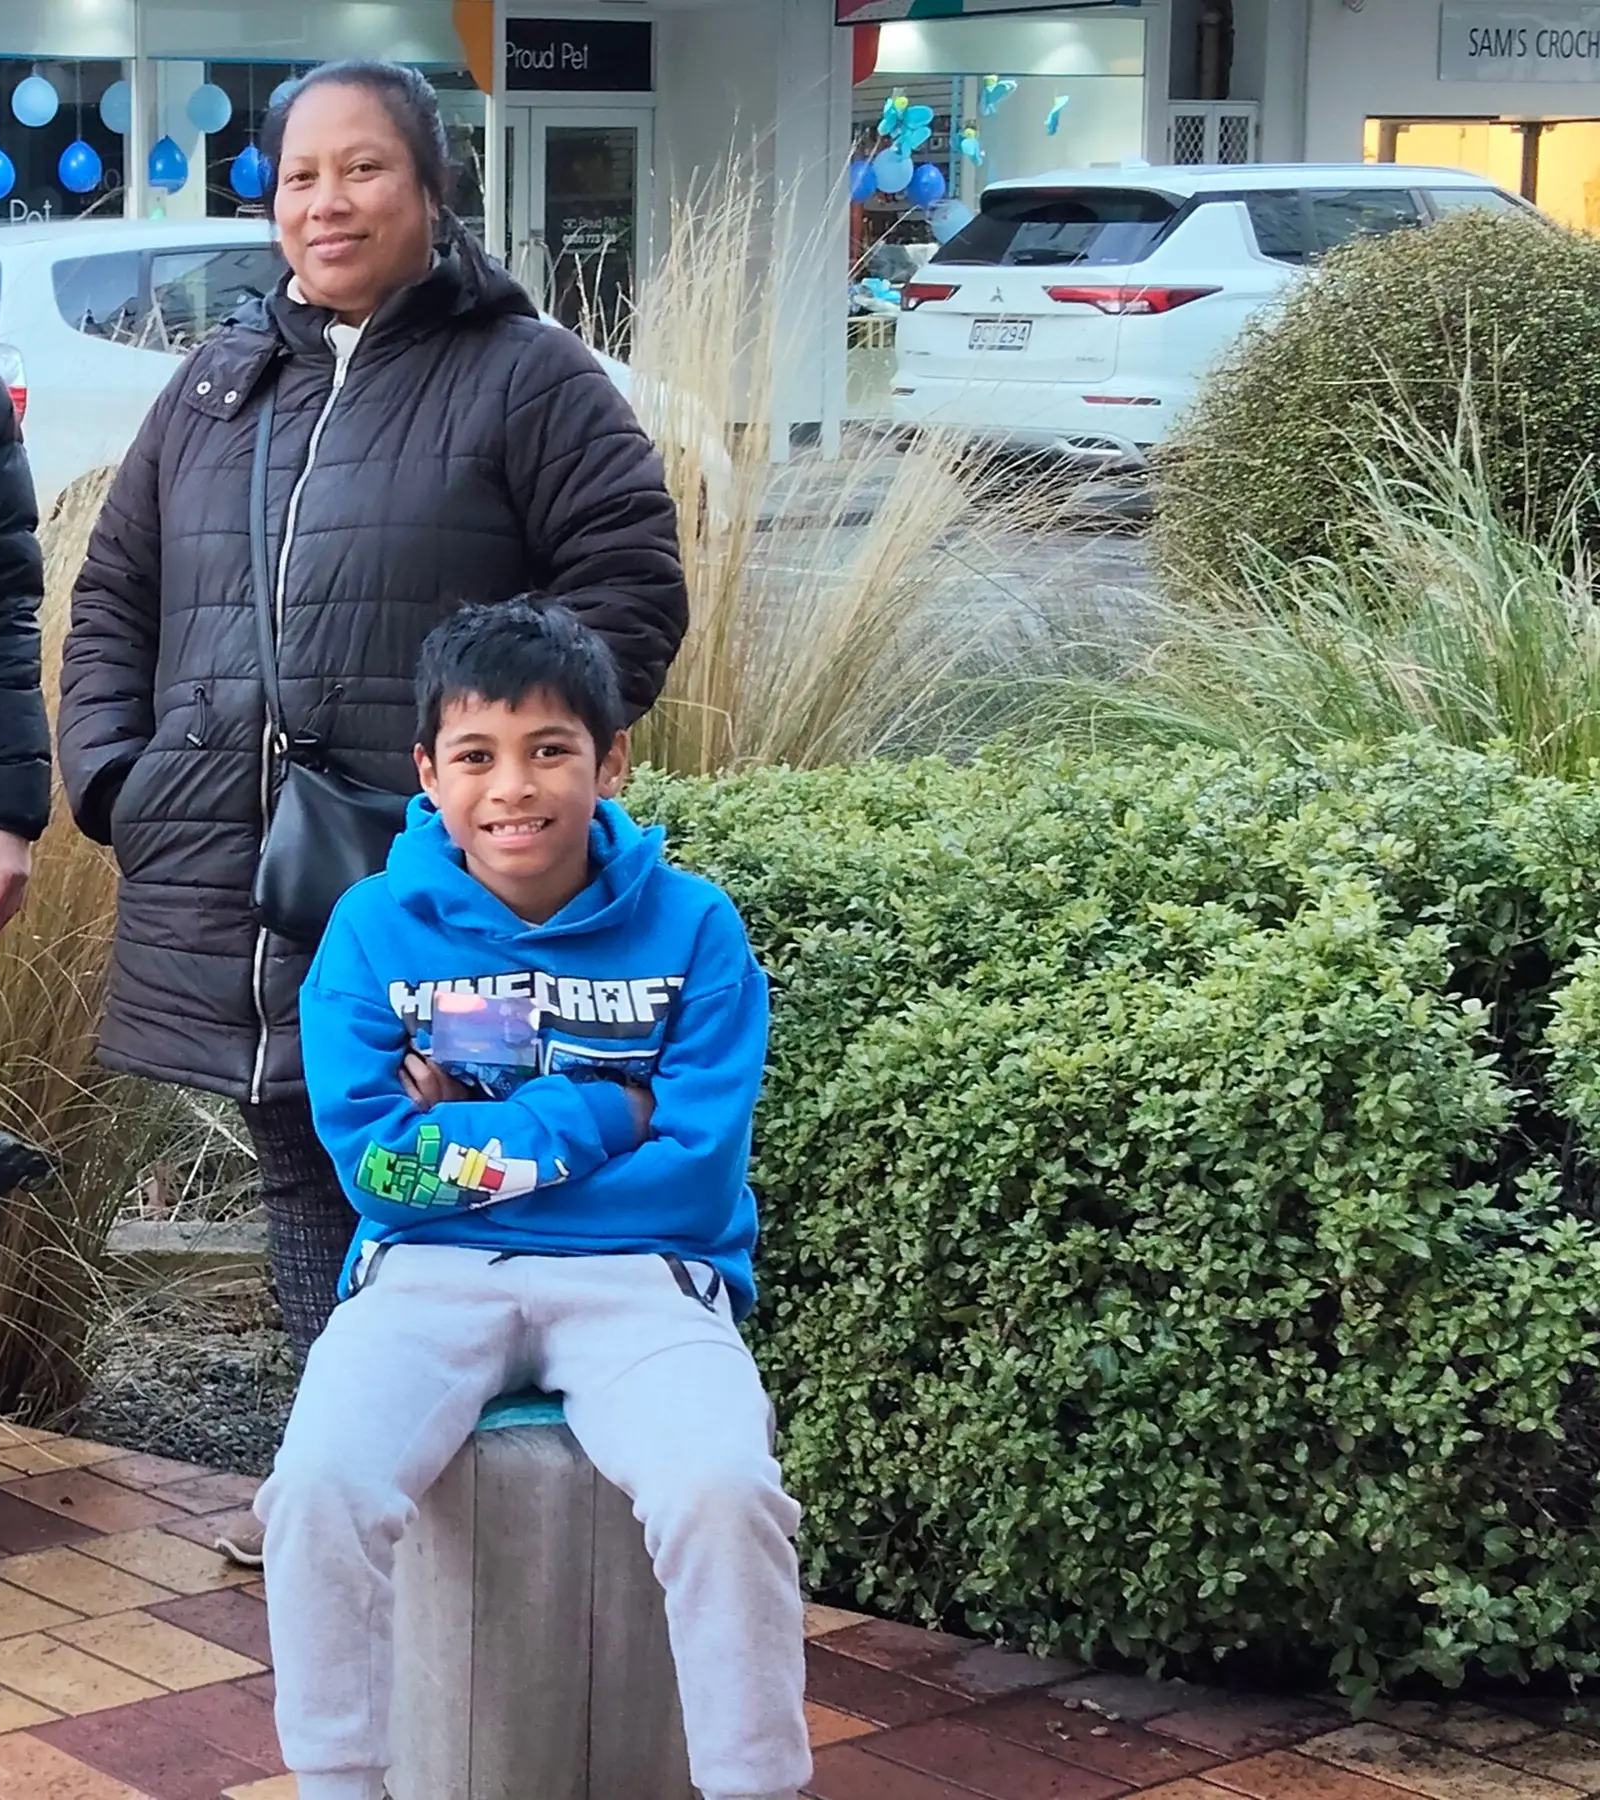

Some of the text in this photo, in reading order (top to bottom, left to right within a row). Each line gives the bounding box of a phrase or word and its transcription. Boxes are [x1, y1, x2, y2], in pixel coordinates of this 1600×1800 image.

[504, 41, 589, 70] Proud Pet
[1468, 28, 1600, 59] SAM'S CROCH
